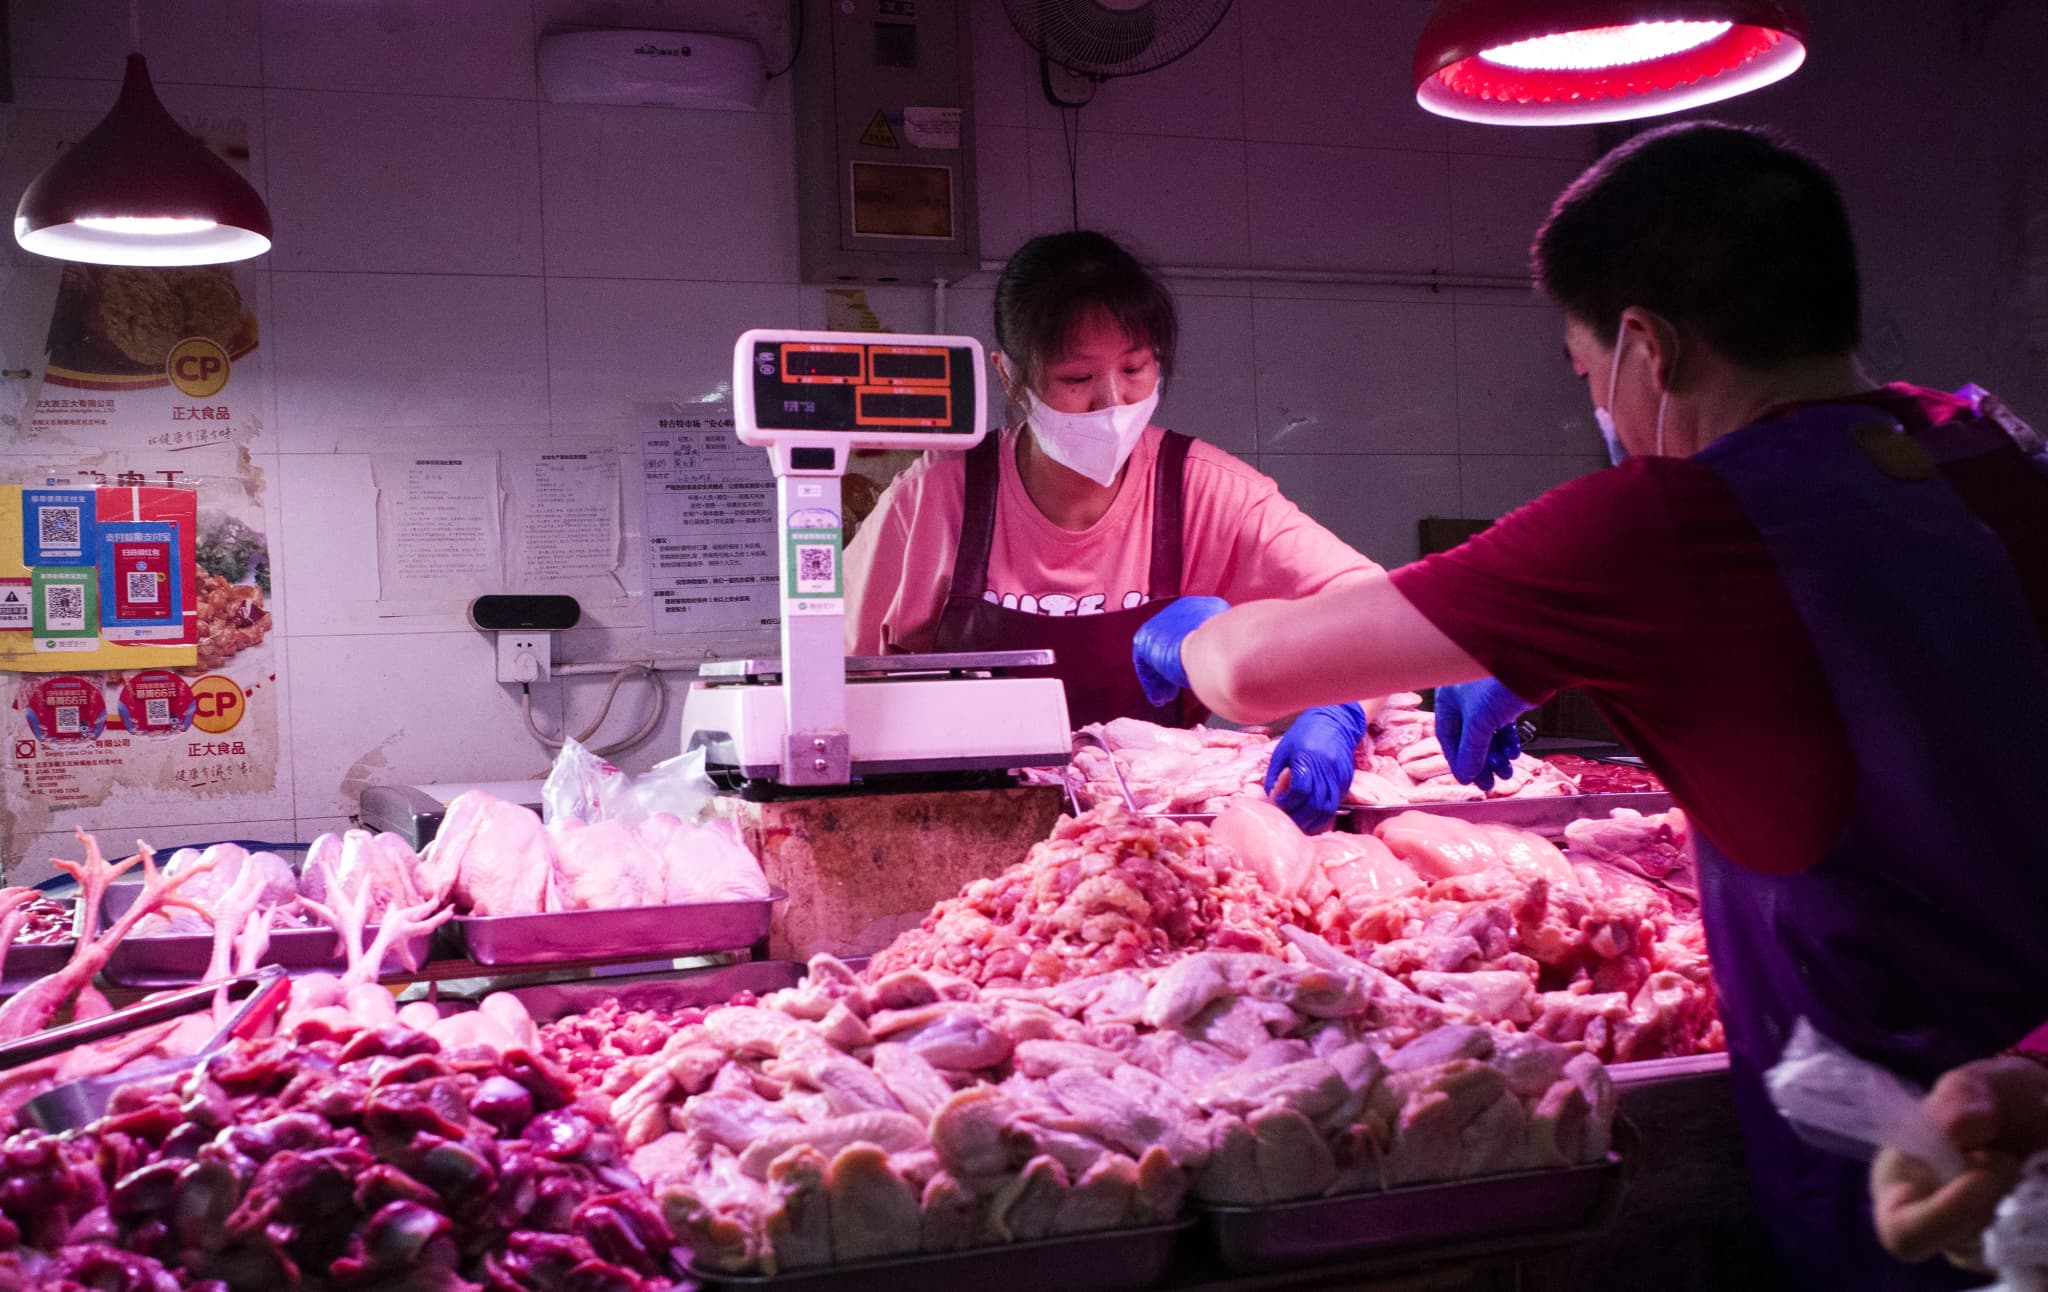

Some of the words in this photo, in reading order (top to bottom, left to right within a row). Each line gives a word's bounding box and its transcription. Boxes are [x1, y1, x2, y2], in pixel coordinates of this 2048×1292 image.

[175, 355, 222, 381] CP
[173, 405, 231, 421] 正大食品
[195, 691, 237, 717] CP
[188, 741, 246, 757] 正大食品
